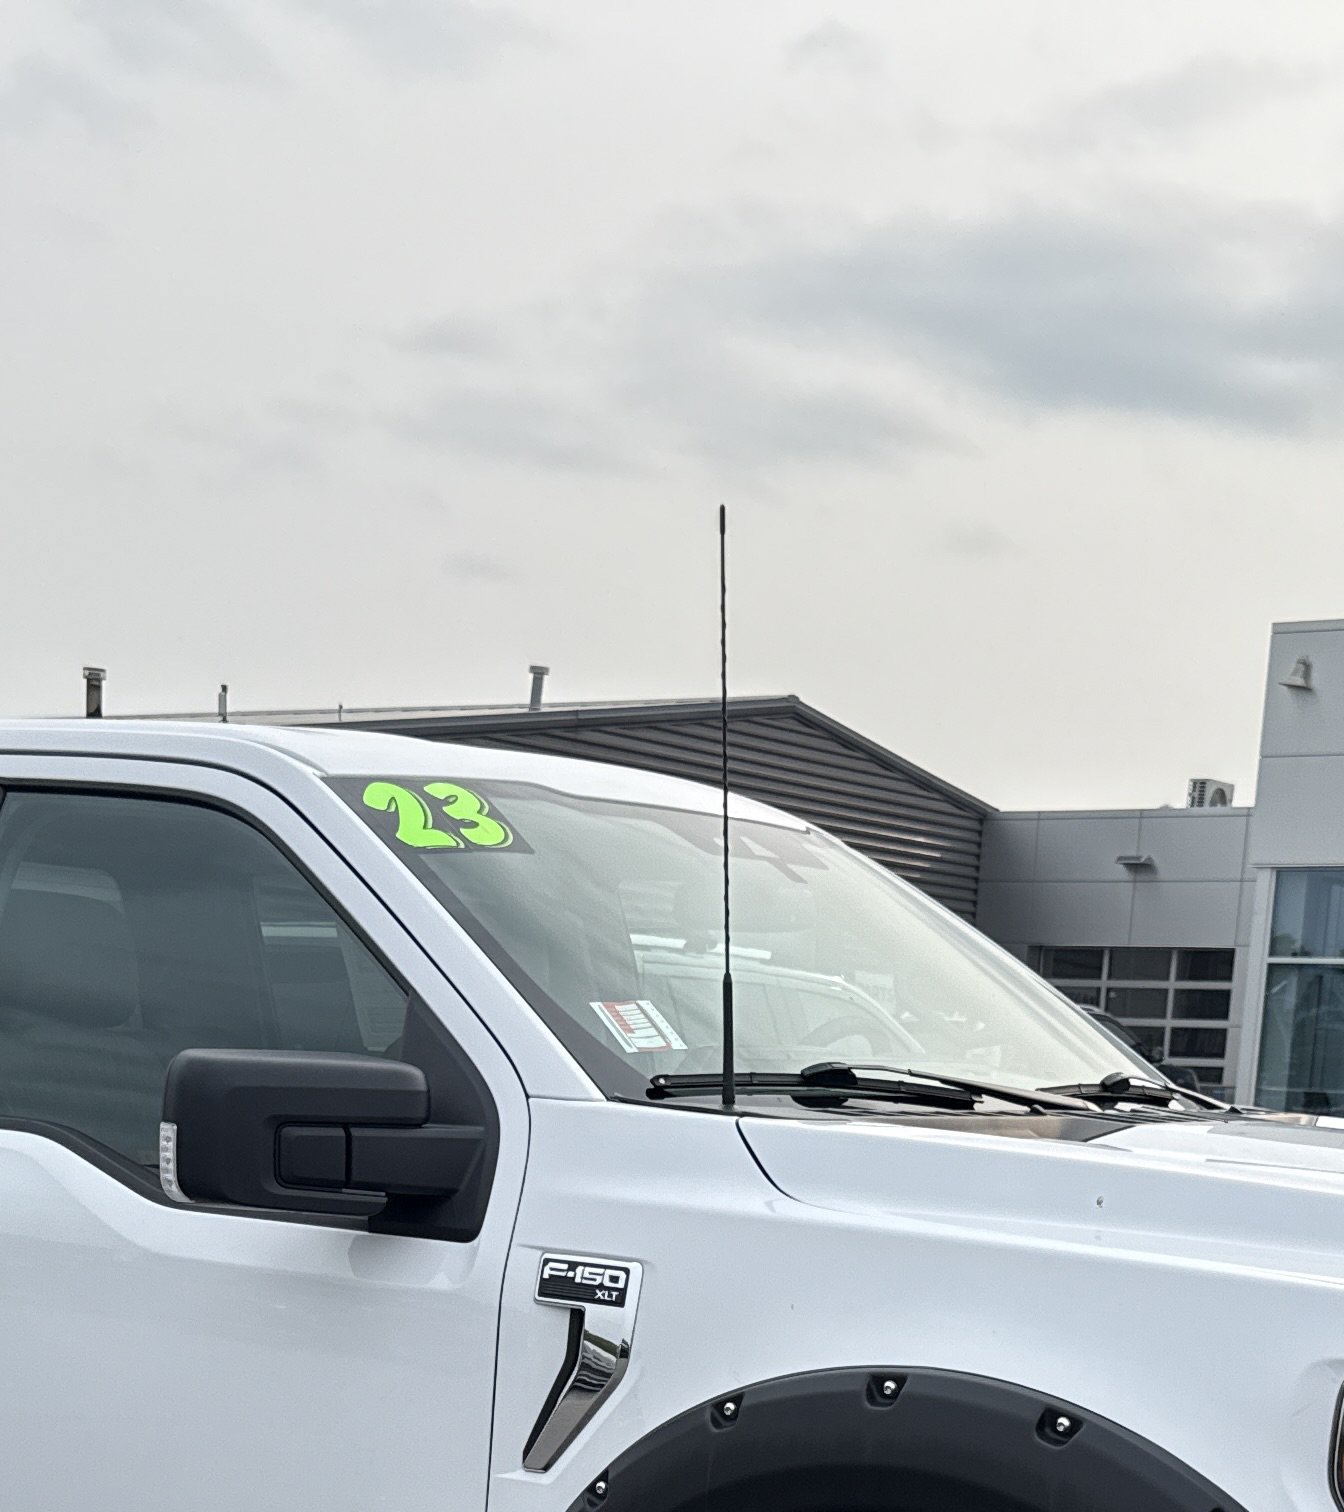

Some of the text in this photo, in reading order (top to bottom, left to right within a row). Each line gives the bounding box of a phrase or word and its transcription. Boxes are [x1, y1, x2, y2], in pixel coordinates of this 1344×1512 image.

[362, 782, 514, 849] 23
[542, 1261, 627, 1289] F-150
[594, 1289, 620, 1302] XLT
